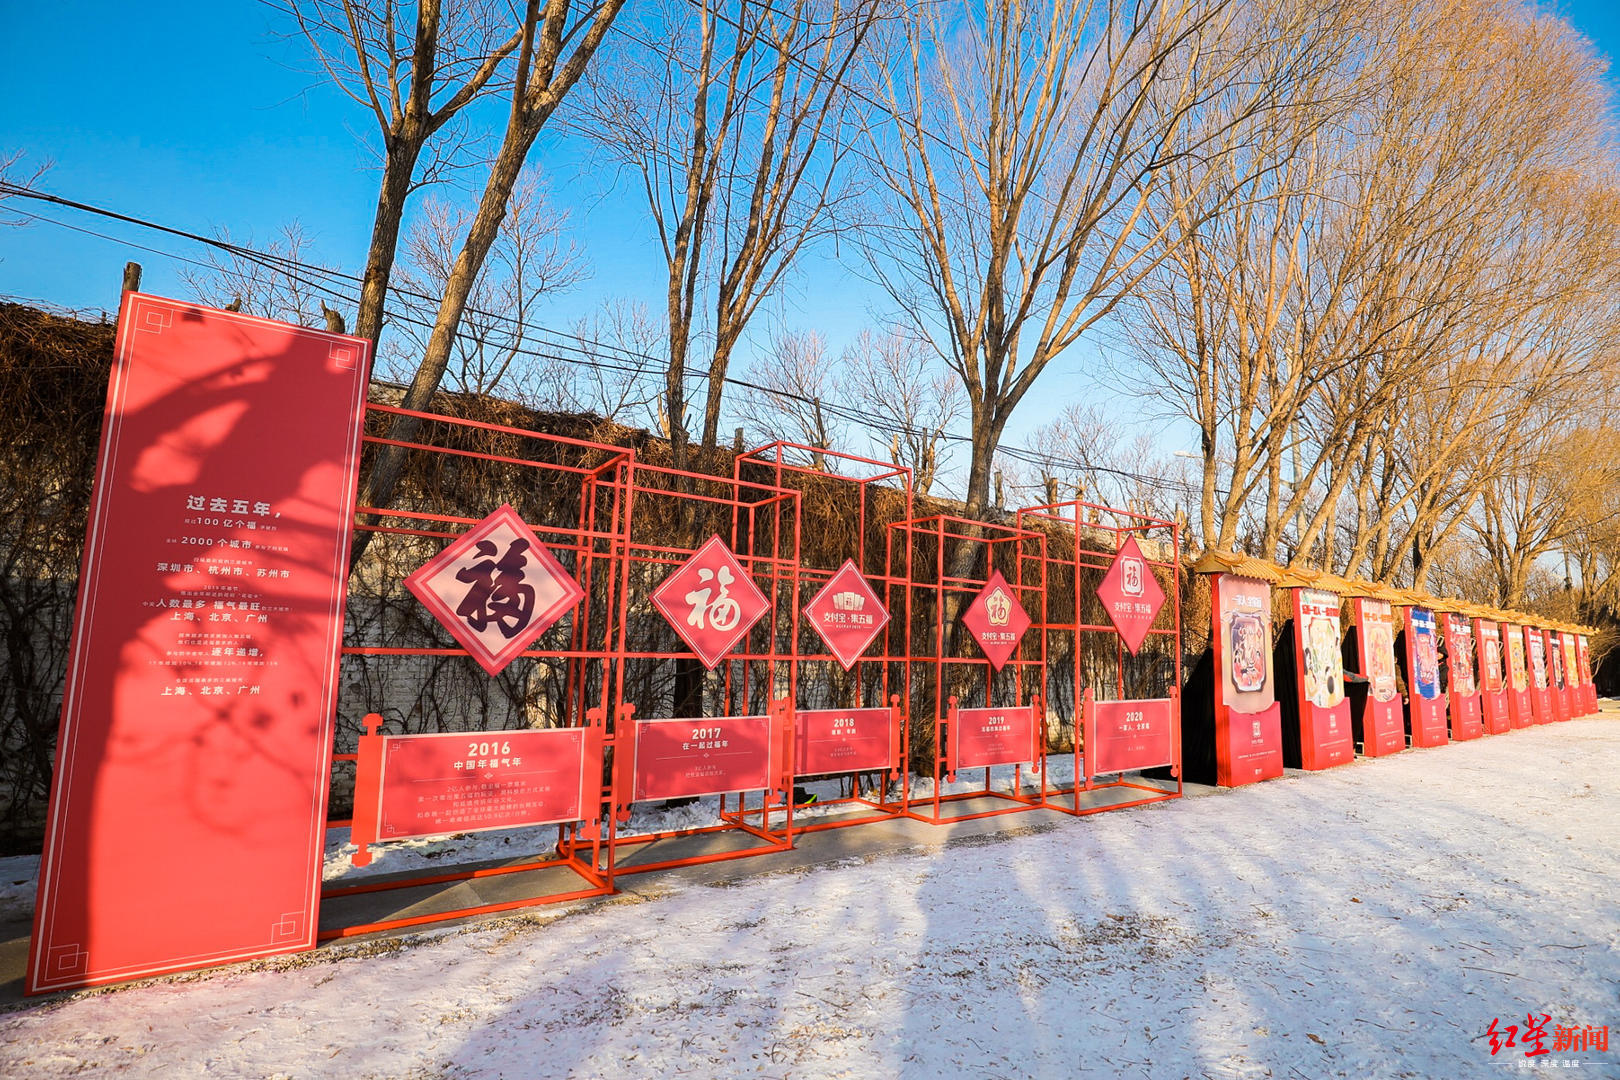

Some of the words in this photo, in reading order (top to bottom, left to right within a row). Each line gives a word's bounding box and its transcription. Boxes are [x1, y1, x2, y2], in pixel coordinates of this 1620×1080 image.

[181, 536, 213, 546] 2000
[455, 537, 536, 639] 福
[685, 565, 741, 632] 福
[989, 716, 1005, 725] 2019
[1126, 711, 1144, 722] 2020
[834, 718, 855, 728] 2018
[692, 728, 722, 740] 2017
[468, 742, 512, 757] 2016
[453, 757, 522, 770] 中国年福气年
